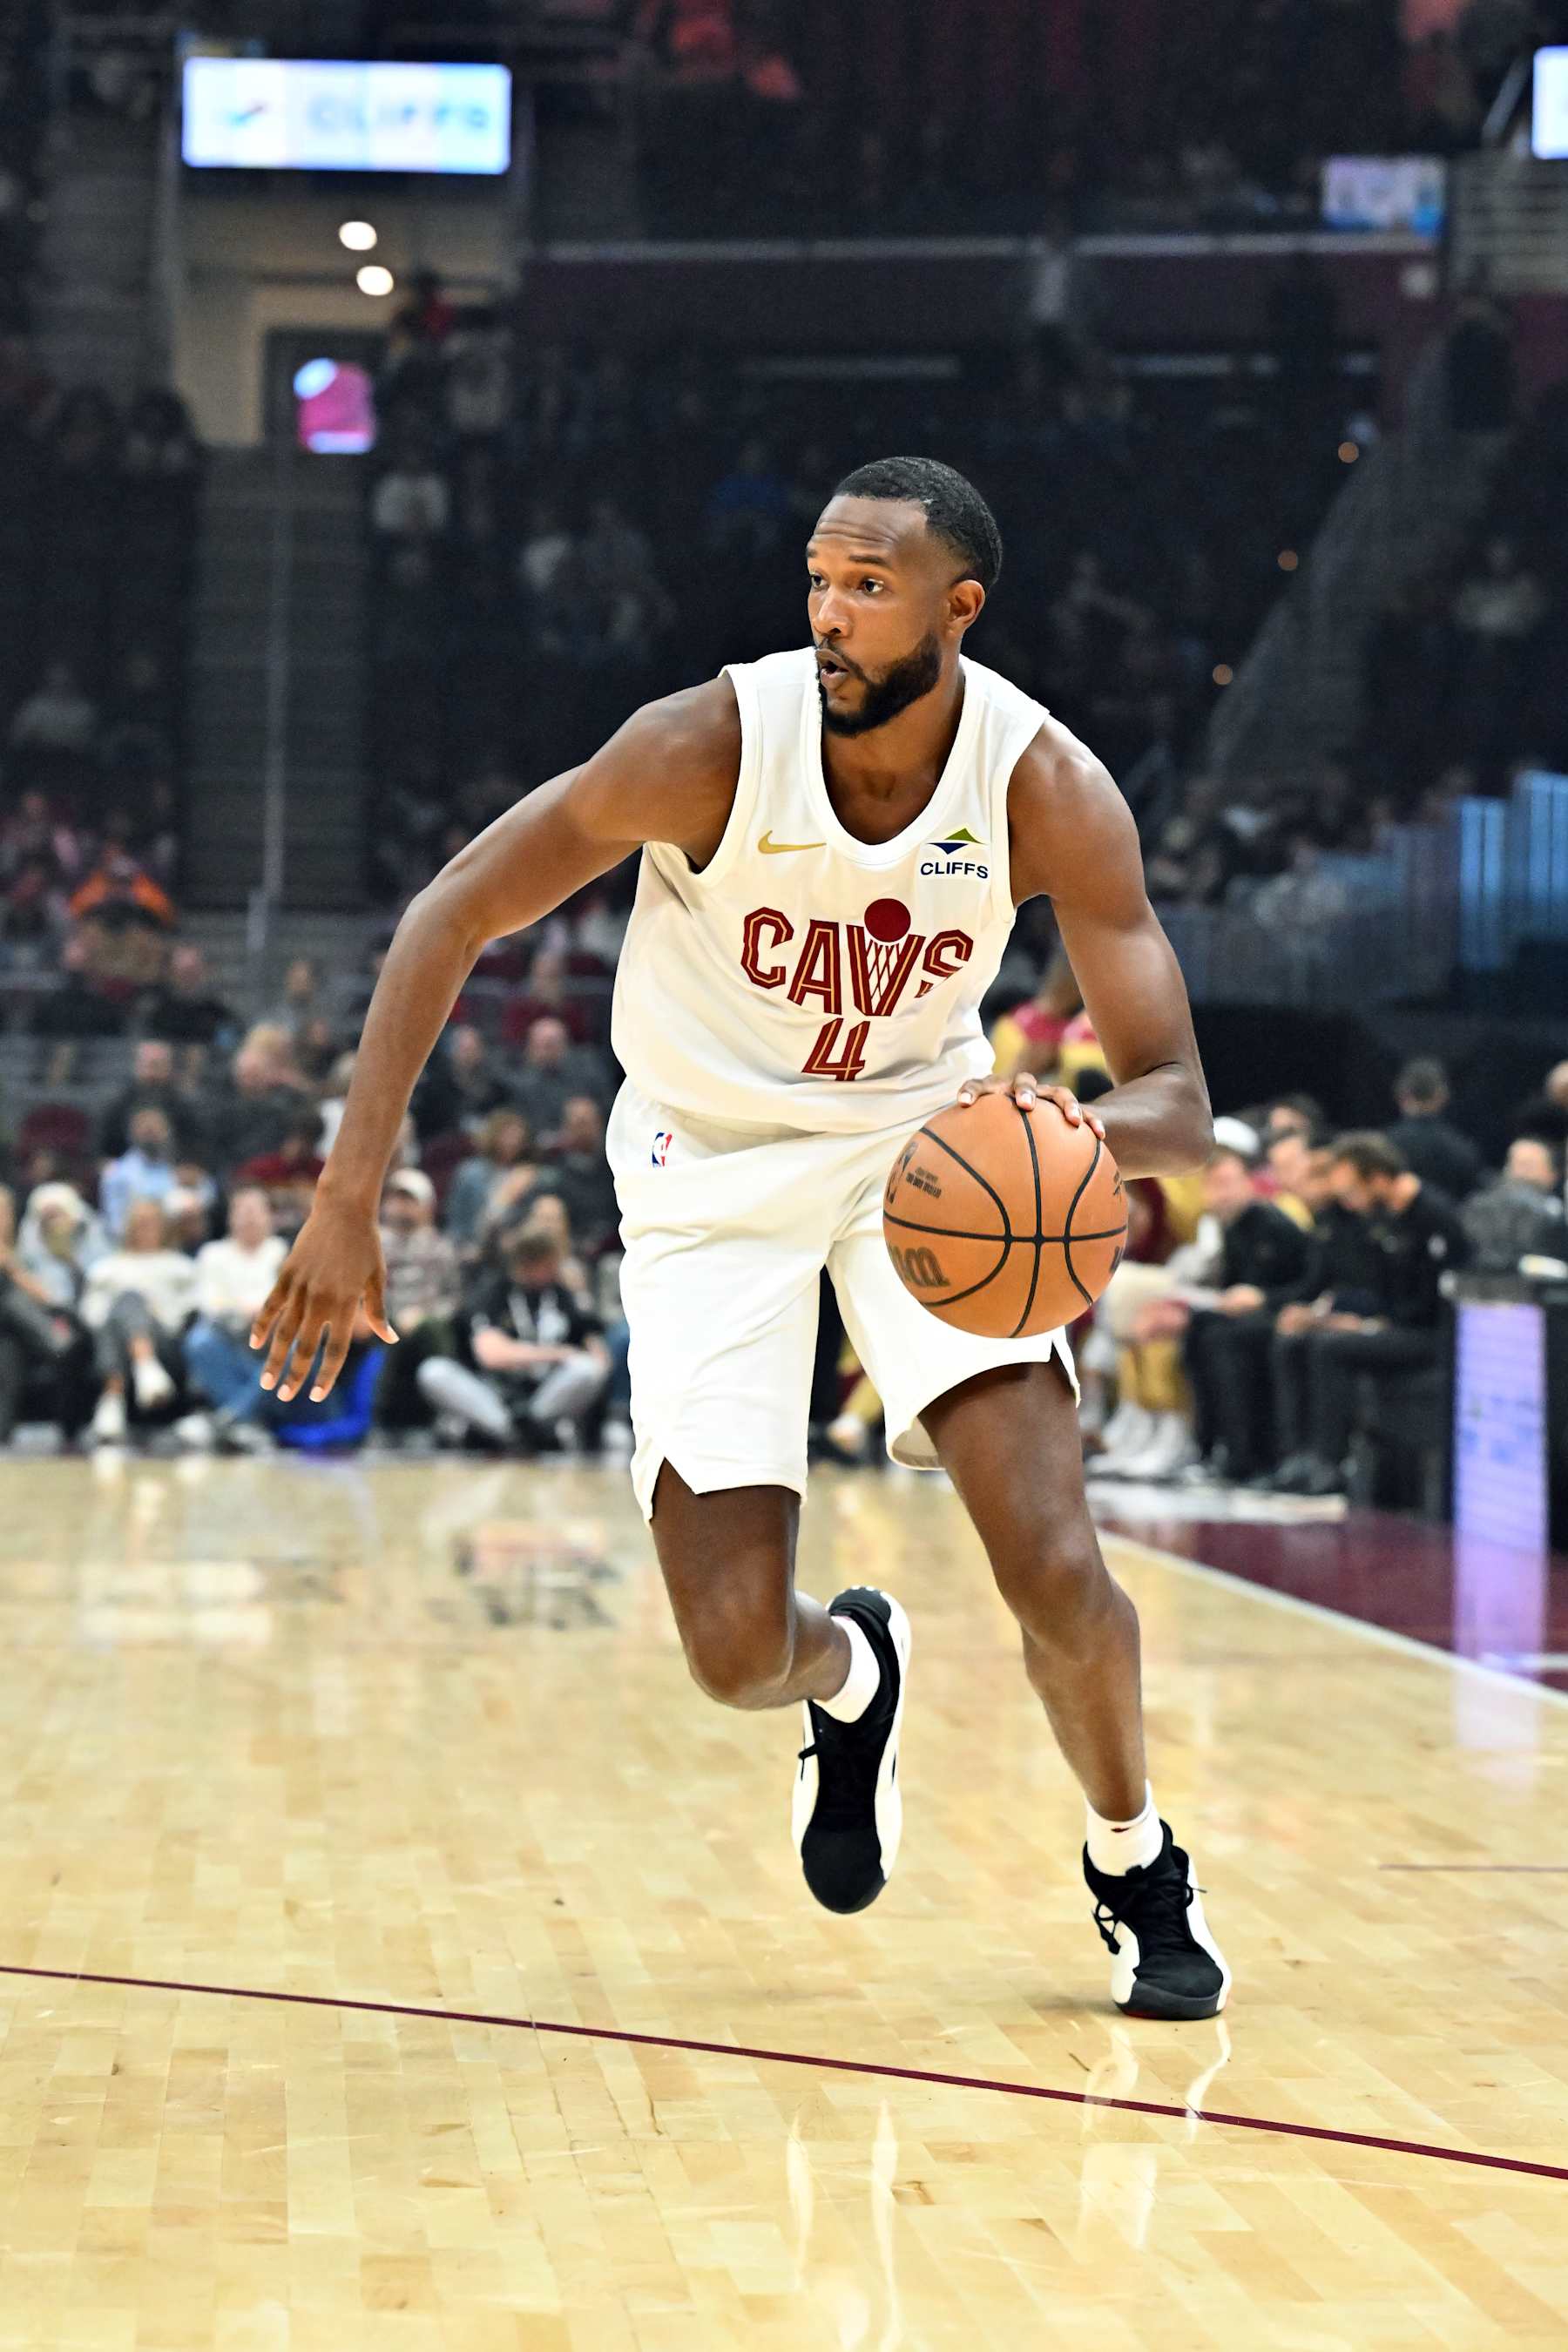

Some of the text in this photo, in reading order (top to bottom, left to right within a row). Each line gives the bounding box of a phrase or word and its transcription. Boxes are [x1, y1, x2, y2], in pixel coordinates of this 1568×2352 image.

[920, 861, 990, 879] CLIFFS
[740, 904, 974, 1017] CAVS
[801, 1017, 870, 1082] 4
